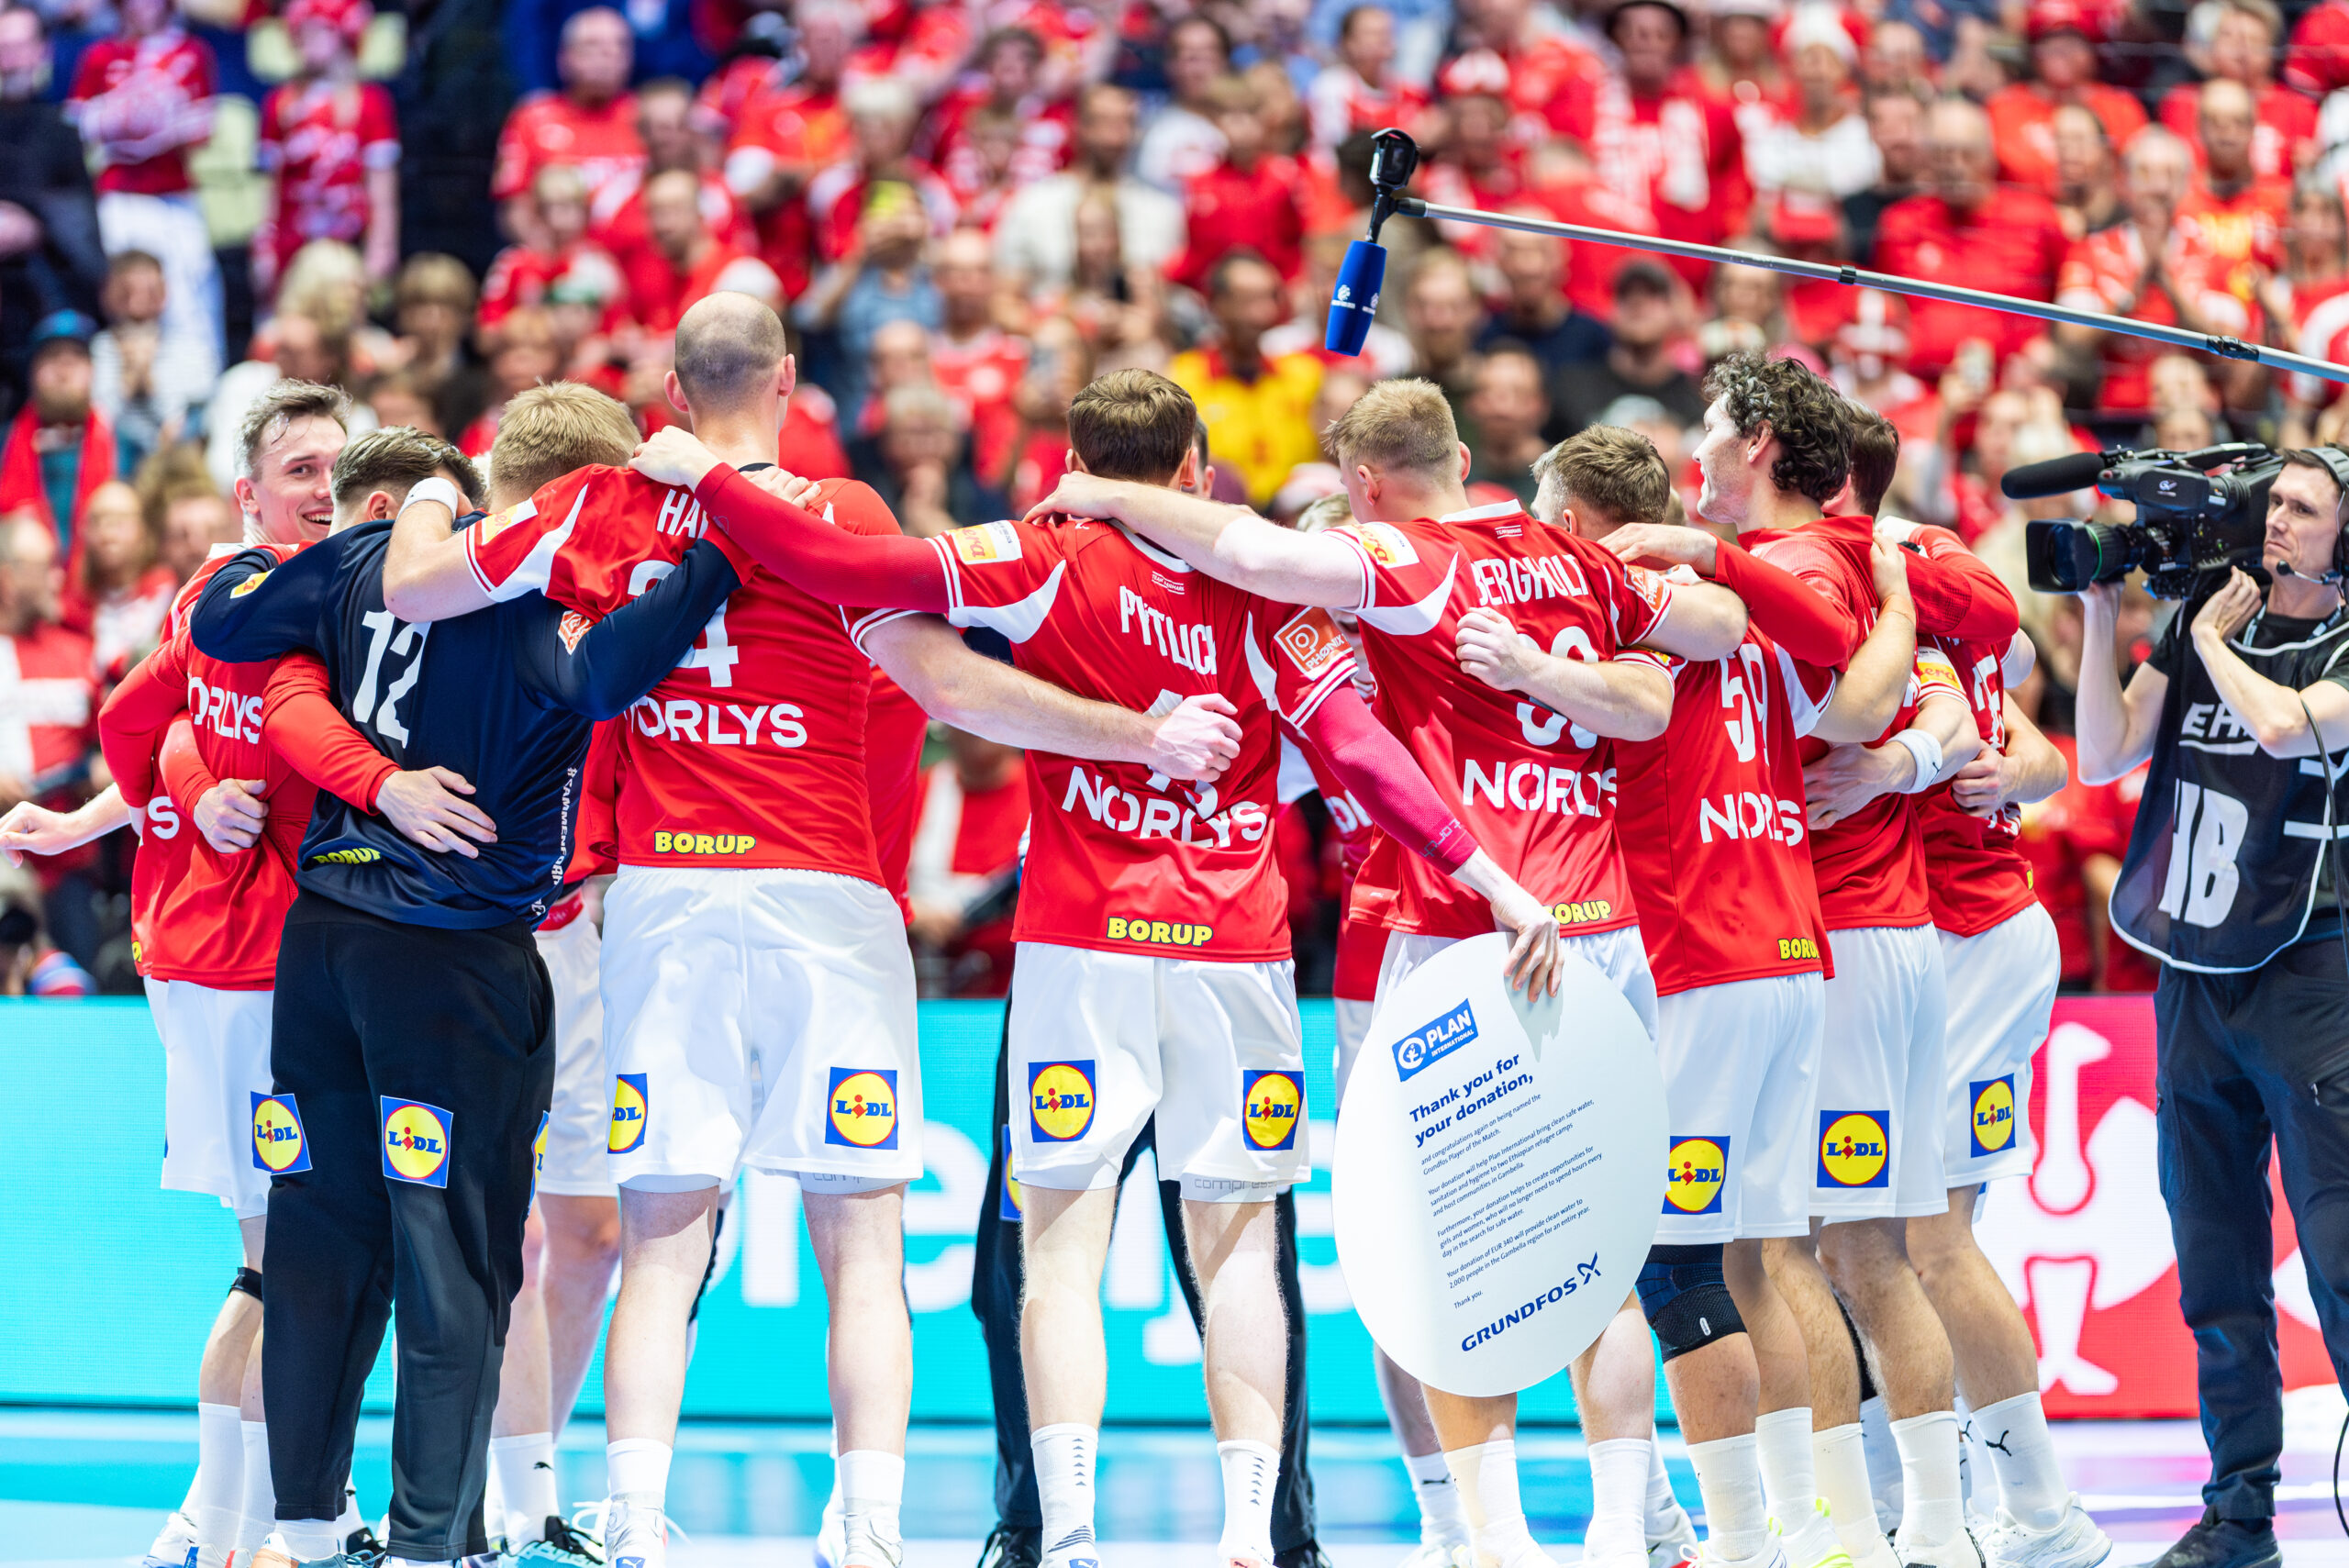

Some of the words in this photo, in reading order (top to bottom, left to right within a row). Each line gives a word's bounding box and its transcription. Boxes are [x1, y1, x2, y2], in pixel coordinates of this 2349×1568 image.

[187, 672, 263, 744] ORLYS
[353, 610, 431, 748] 12
[625, 695, 808, 749] ORLYS
[2182, 702, 2248, 739] EH
[1062, 765, 1269, 848] NORLYS
[654, 831, 756, 854] BORUP
[1107, 917, 1213, 947] BORUP
[1542, 900, 1611, 925] ORUP
[1777, 937, 1820, 960] BORU
[1426, 1009, 1472, 1049] PLAN
[1431, 1029, 1474, 1057] INTERNATIONAL
[613, 1106, 642, 1122] DL
[1409, 1087, 1461, 1122] Thank
[1463, 1070, 1493, 1097] you
[1496, 1054, 1519, 1074] for
[1415, 1116, 1452, 1148] your
[1455, 1073, 1532, 1120] donation,
[1421, 1154, 1431, 1165] and
[1431, 1132, 1473, 1159] congratulations
[1474, 1123, 1488, 1136] again
[1497, 1110, 1512, 1122] being
[1512, 1097, 1531, 1113] named
[1531, 1094, 1541, 1102] the
[1423, 1158, 1448, 1174] Grundfos
[1448, 1148, 1464, 1161] Player
[1465, 1142, 1471, 1151] of
[1472, 1139, 1481, 1148] the
[1428, 1185, 1440, 1195] Your
[1441, 1172, 1464, 1188] donation
[1465, 1164, 1475, 1174] will
[1475, 1159, 1488, 1169] help
[1488, 1151, 1500, 1162] Plan
[1535, 1123, 1551, 1135] bring
[1551, 1116, 1565, 1127] clean
[1565, 1108, 1576, 1118] safe
[1431, 1187, 1457, 1207] sanitation
[1458, 1179, 1468, 1191] and
[1468, 1169, 1490, 1184] hygiene
[1497, 1159, 1508, 1169] two
[1508, 1144, 1534, 1162] Ethiopian
[1534, 1132, 1554, 1147] refugee
[1555, 1123, 1573, 1136] camps
[1472, 1207, 1485, 1219] your
[1486, 1193, 1509, 1210] donation
[1509, 1184, 1525, 1196] helps
[1531, 1171, 1549, 1184] create
[1549, 1151, 1585, 1174] opportunities
[1433, 1206, 1443, 1217] and
[1443, 1199, 1456, 1210] host
[1456, 1181, 1491, 1203] communities
[1440, 1237, 1452, 1250] girls
[1453, 1229, 1463, 1240] and
[1485, 1211, 1497, 1221] who
[1497, 1204, 1508, 1215] will
[1516, 1191, 1533, 1204] longer
[1534, 1182, 1548, 1195] need
[1554, 1168, 1571, 1184] spend
[1571, 1162, 1587, 1173] hours
[1587, 1152, 1602, 1164] every
[1442, 1249, 1452, 1258] day
[1458, 1240, 1468, 1248] the
[1468, 1229, 1486, 1243] search
[1495, 1218, 1507, 1228] safe
[1446, 1268, 1459, 1277] Your
[1459, 1254, 1484, 1271] donation
[1484, 1248, 1490, 1257] of
[1490, 1242, 1502, 1253] EUR
[1503, 1236, 1513, 1247] 340
[1513, 1229, 1524, 1240] will
[1524, 1219, 1544, 1236] provide
[1545, 1211, 1560, 1223] clean
[1560, 1202, 1575, 1215] water
[1449, 1275, 1464, 1288] 2,000
[1465, 1266, 1484, 1281] people
[1490, 1256, 1500, 1265] the
[1500, 1242, 1526, 1259] Gambella
[1527, 1232, 1543, 1245] region
[1553, 1222, 1560, 1230] an
[1561, 1213, 1576, 1226] entire
[1453, 1296, 1471, 1308] Thank
[1461, 1276, 1576, 1351] GRUNDFOS
